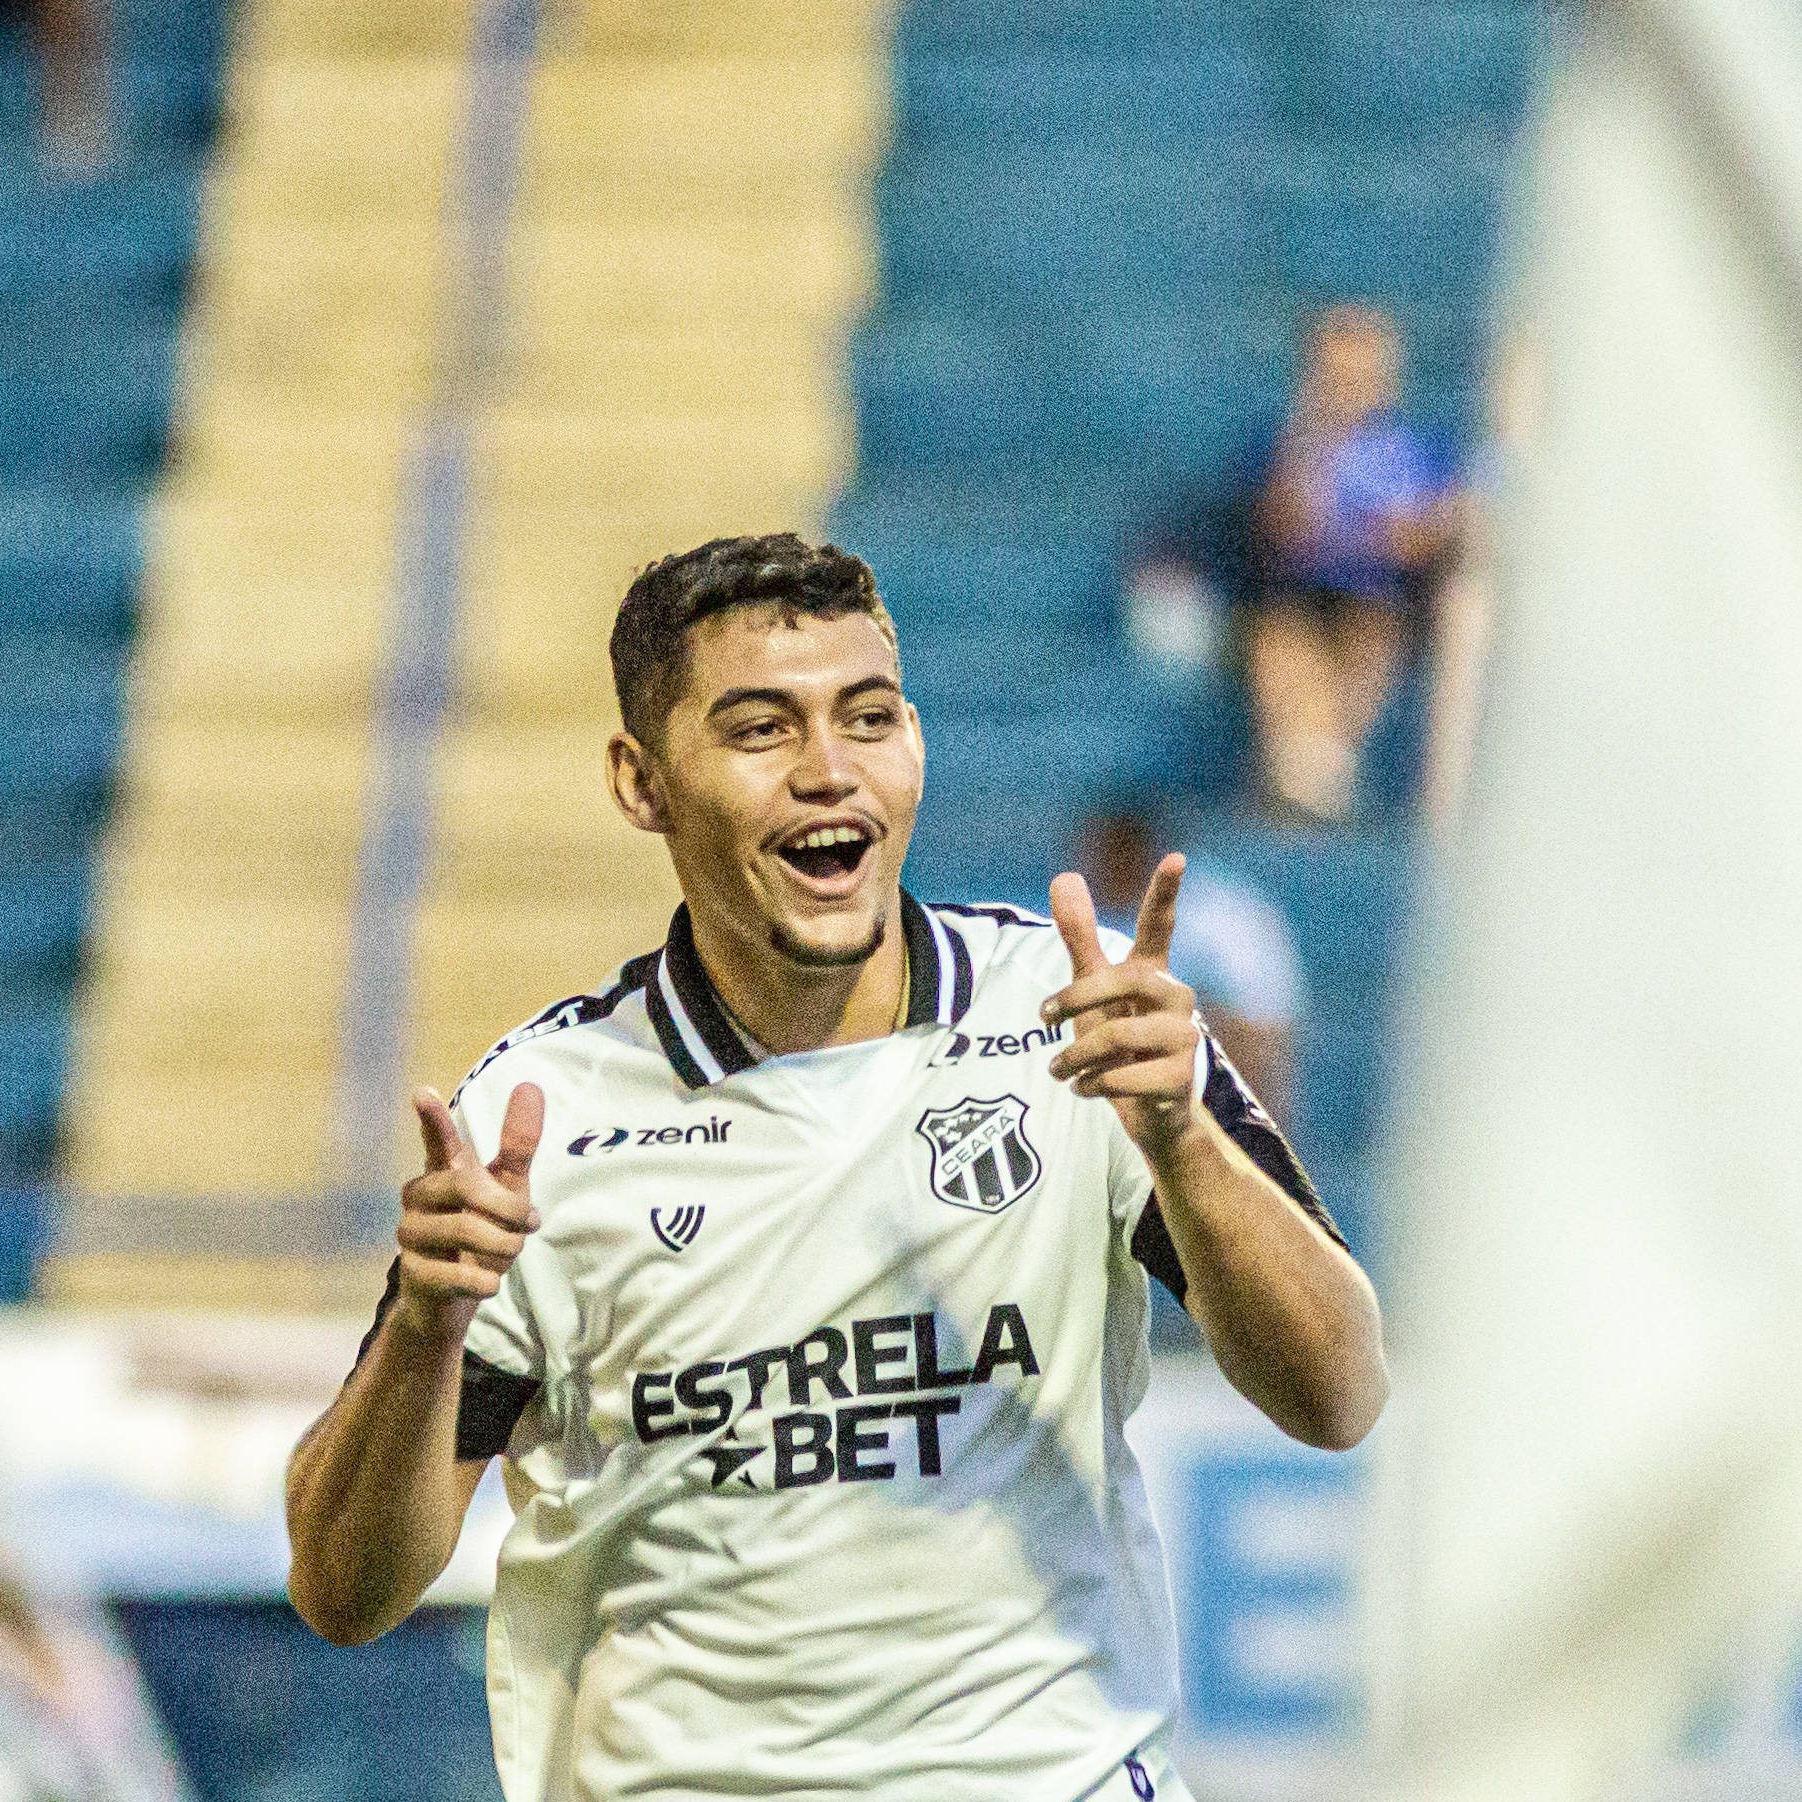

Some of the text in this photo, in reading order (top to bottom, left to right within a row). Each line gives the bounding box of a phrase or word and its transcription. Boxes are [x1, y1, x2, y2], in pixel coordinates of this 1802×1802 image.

[635, 1115, 733, 1147] zenir
[941, 1108, 1017, 1177] CEARÁ
[631, 1302, 1041, 1444] ESTRELA
[772, 1396, 961, 1490] BET
